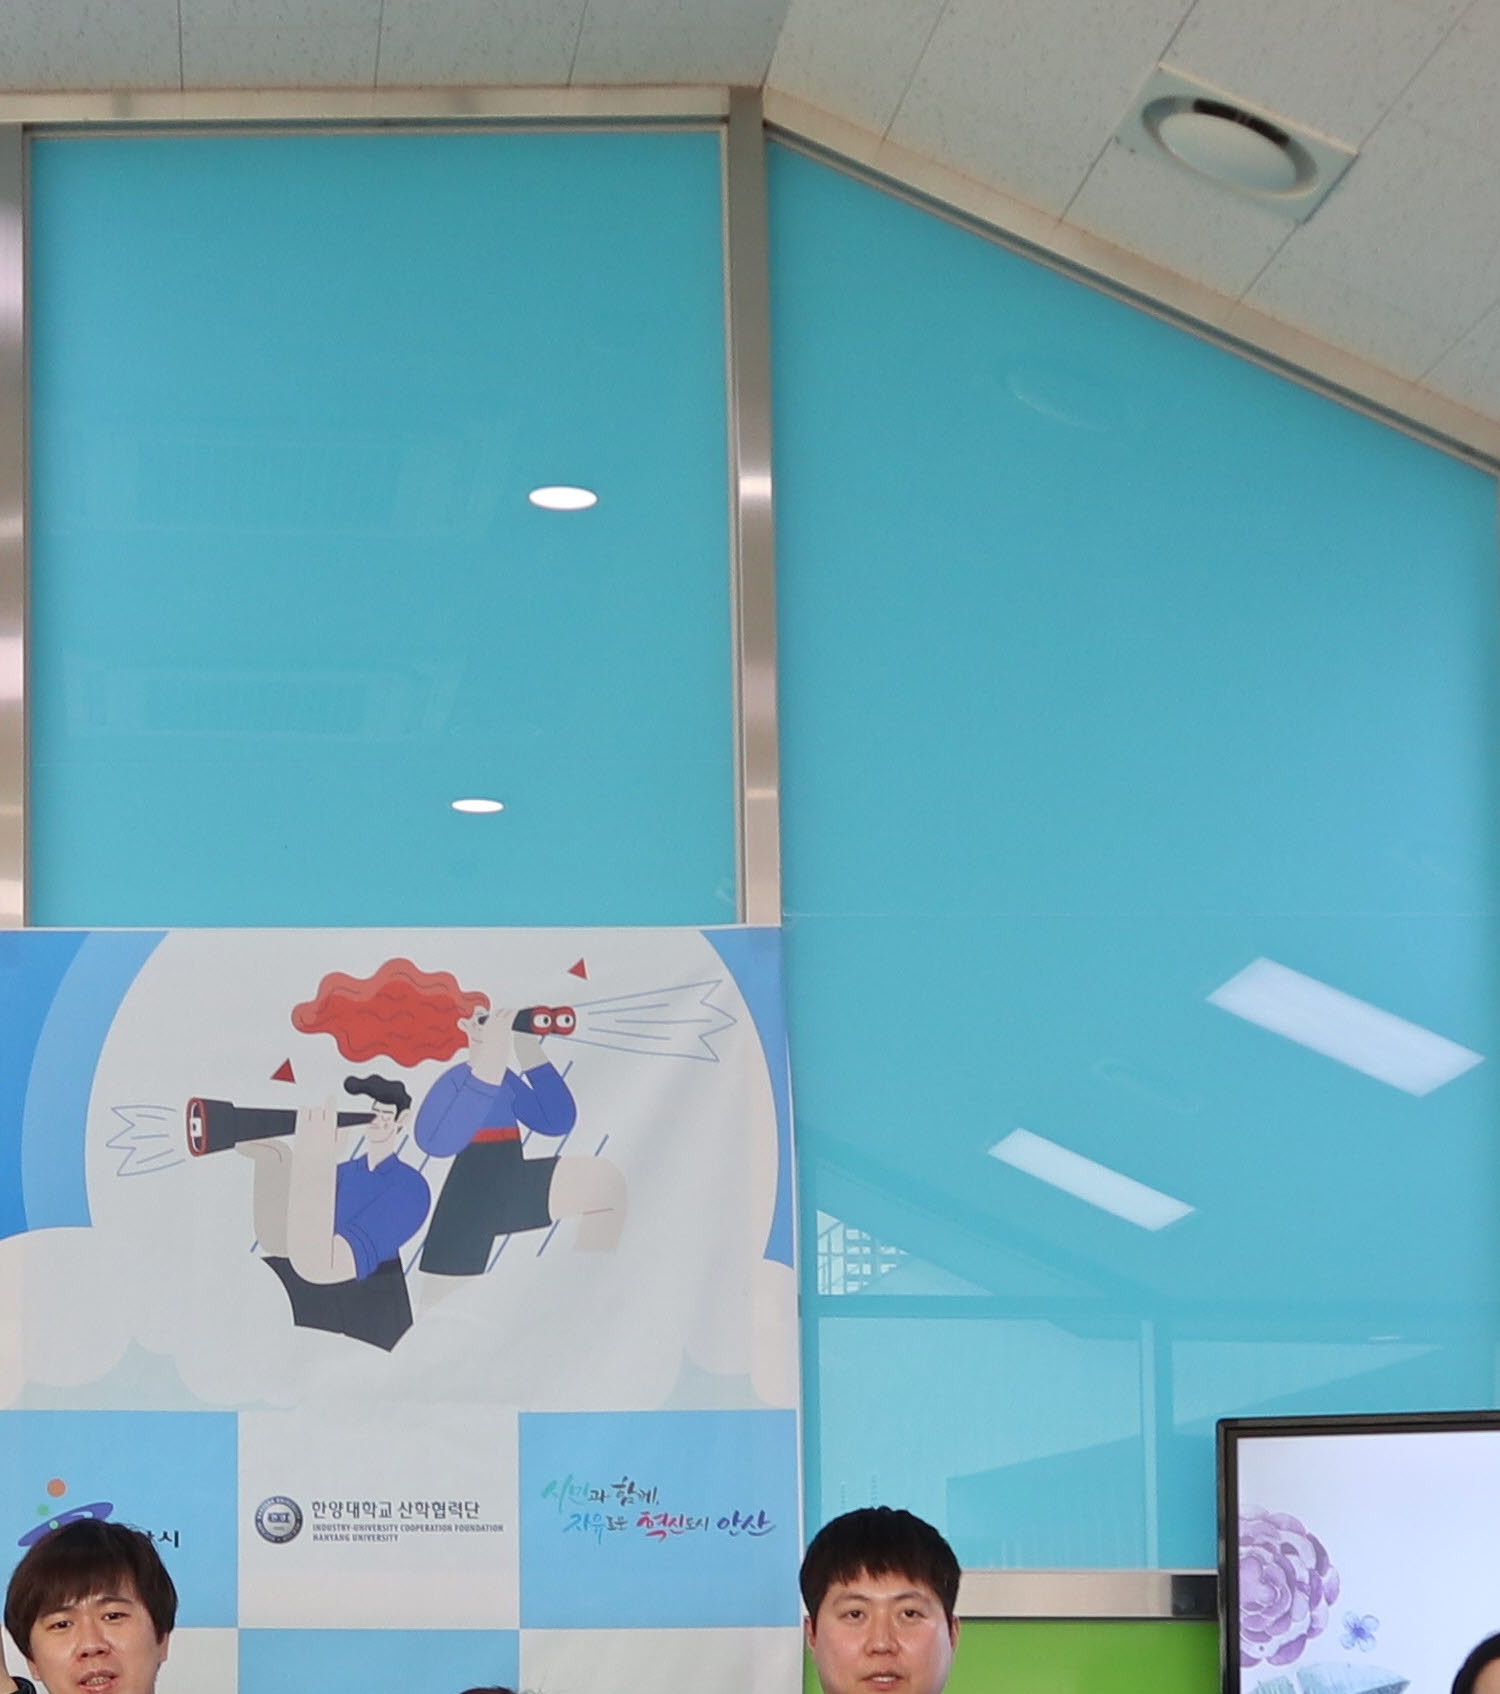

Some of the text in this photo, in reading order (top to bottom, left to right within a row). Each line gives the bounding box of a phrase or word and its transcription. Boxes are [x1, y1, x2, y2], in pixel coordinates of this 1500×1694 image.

[541, 1474, 609, 1514] 시민과
[312, 1501, 480, 1519] 한양대학교 산학협력단
[313, 1533, 398, 1542] HANYANG UNIVERSITY
[636, 1510, 710, 1542] 혁신도시
[717, 1510, 777, 1537] 안산
